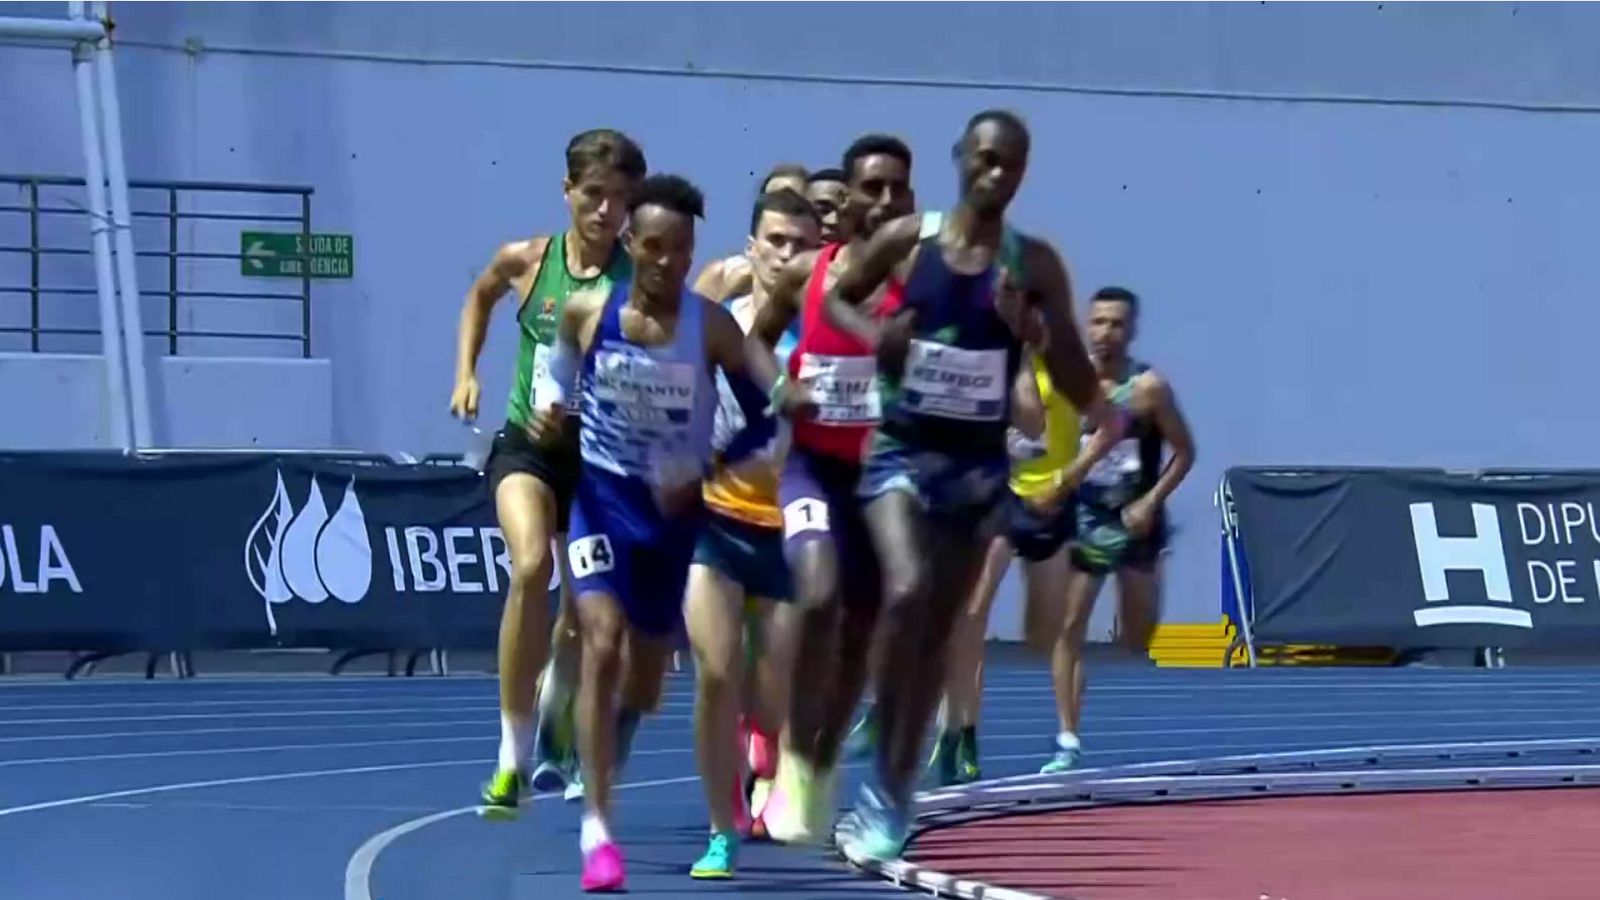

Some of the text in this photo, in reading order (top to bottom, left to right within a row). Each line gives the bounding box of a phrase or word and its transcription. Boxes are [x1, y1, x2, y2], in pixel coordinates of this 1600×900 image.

[295, 235, 349, 254] SLIDA DE
[280, 257, 349, 275] EMEGENCIA
[798, 503, 813, 522] 1
[0, 524, 83, 593] LA
[577, 538, 611, 569] 14
[1527, 560, 1585, 603] DE
